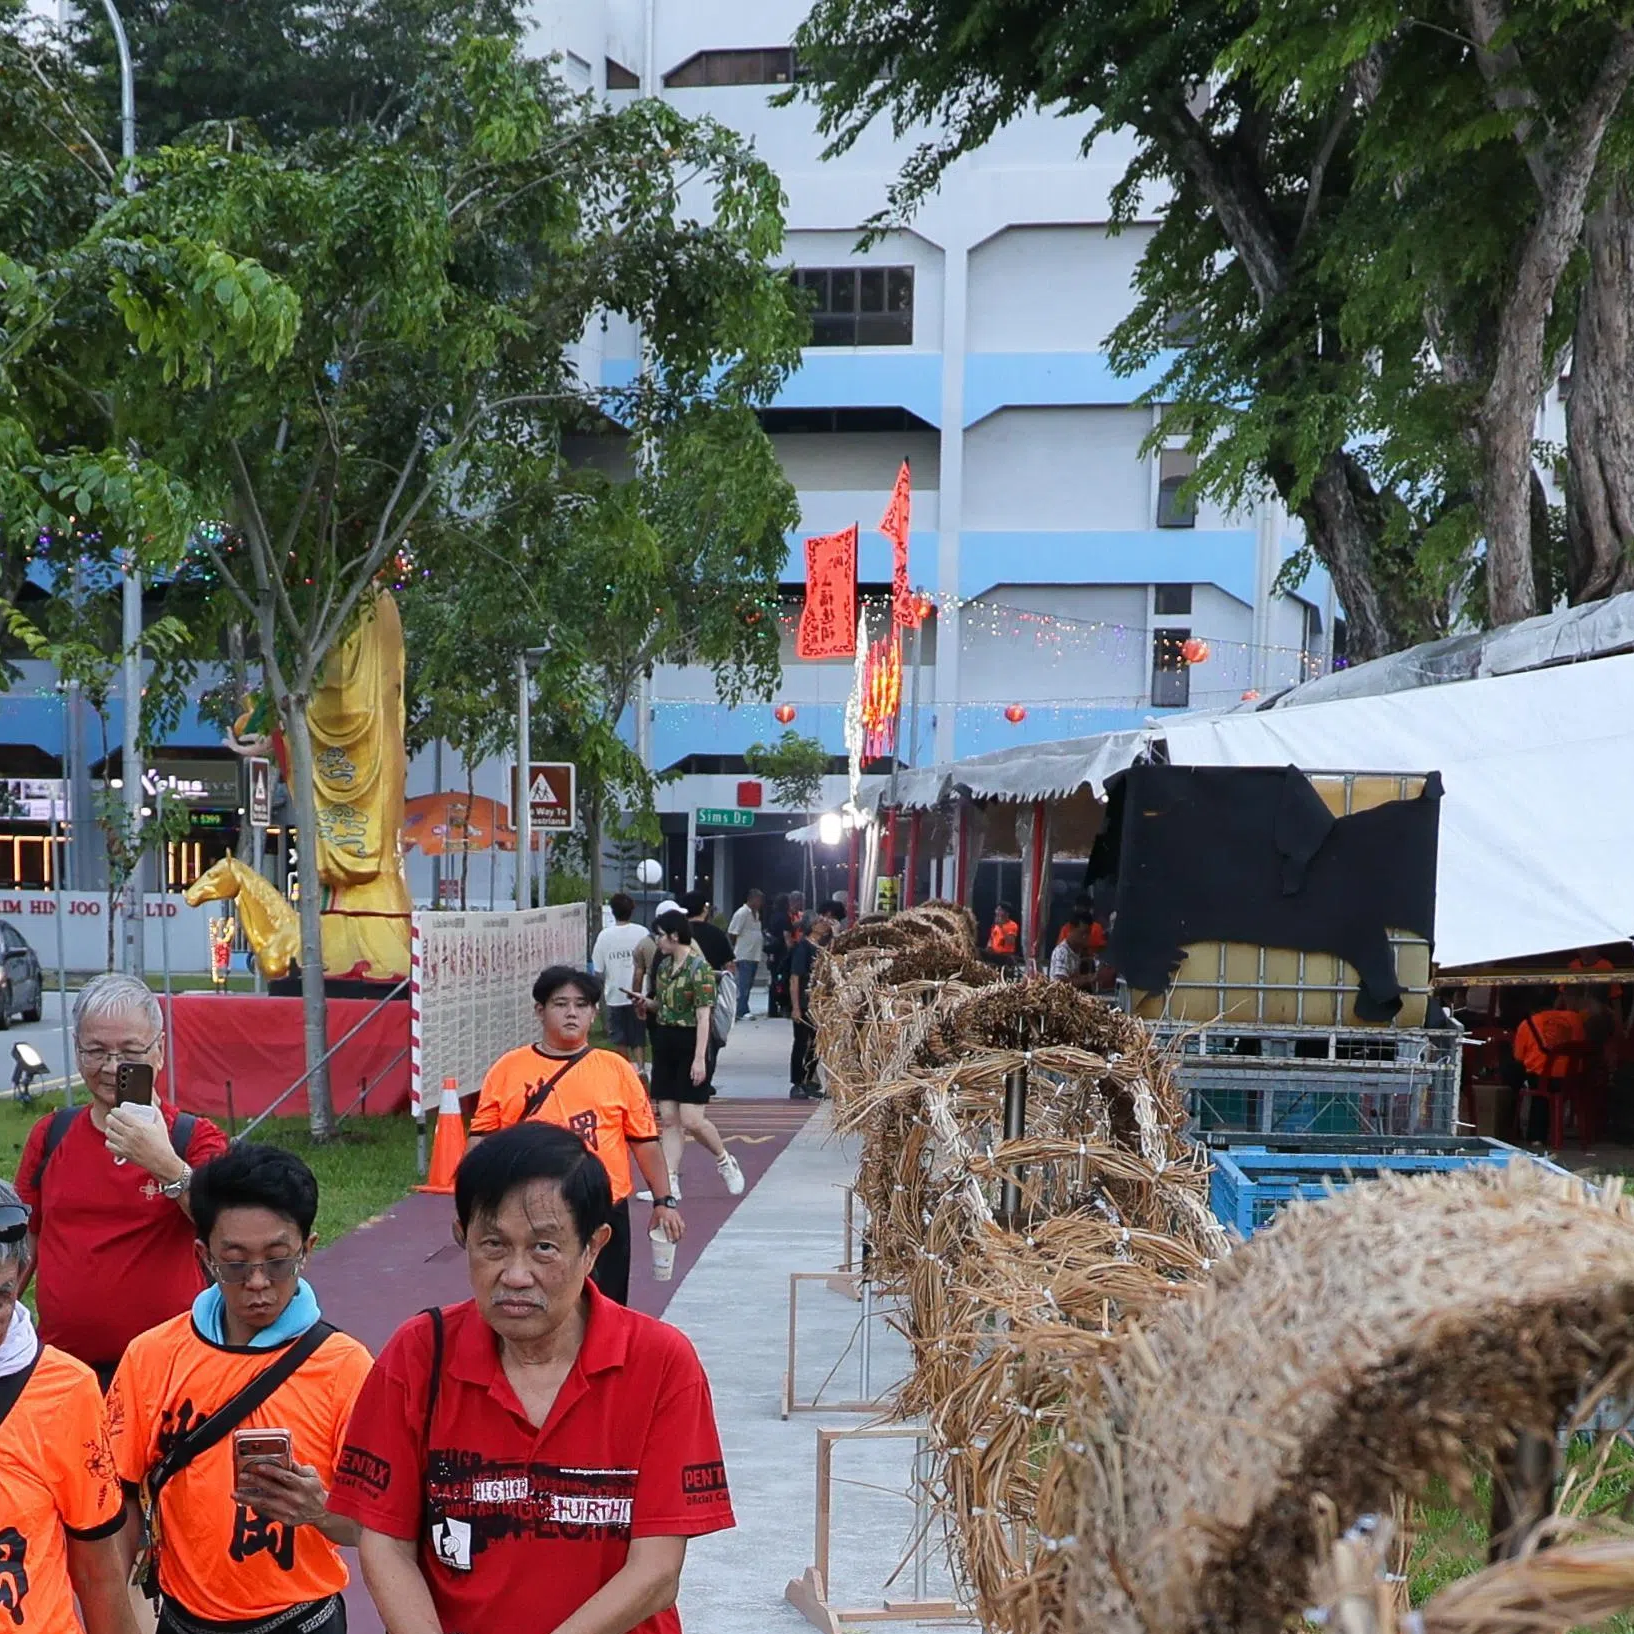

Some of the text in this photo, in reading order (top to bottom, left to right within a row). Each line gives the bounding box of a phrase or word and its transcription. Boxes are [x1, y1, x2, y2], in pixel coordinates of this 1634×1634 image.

[536, 808, 554, 818] Way
[556, 808, 567, 816] To
[699, 810, 747, 824] Sims Dr
[69, 901, 101, 916] JOO
[146, 902, 178, 917] LTD
[340, 1449, 389, 1486] ENTAX
[473, 1479, 528, 1501] HIGHER
